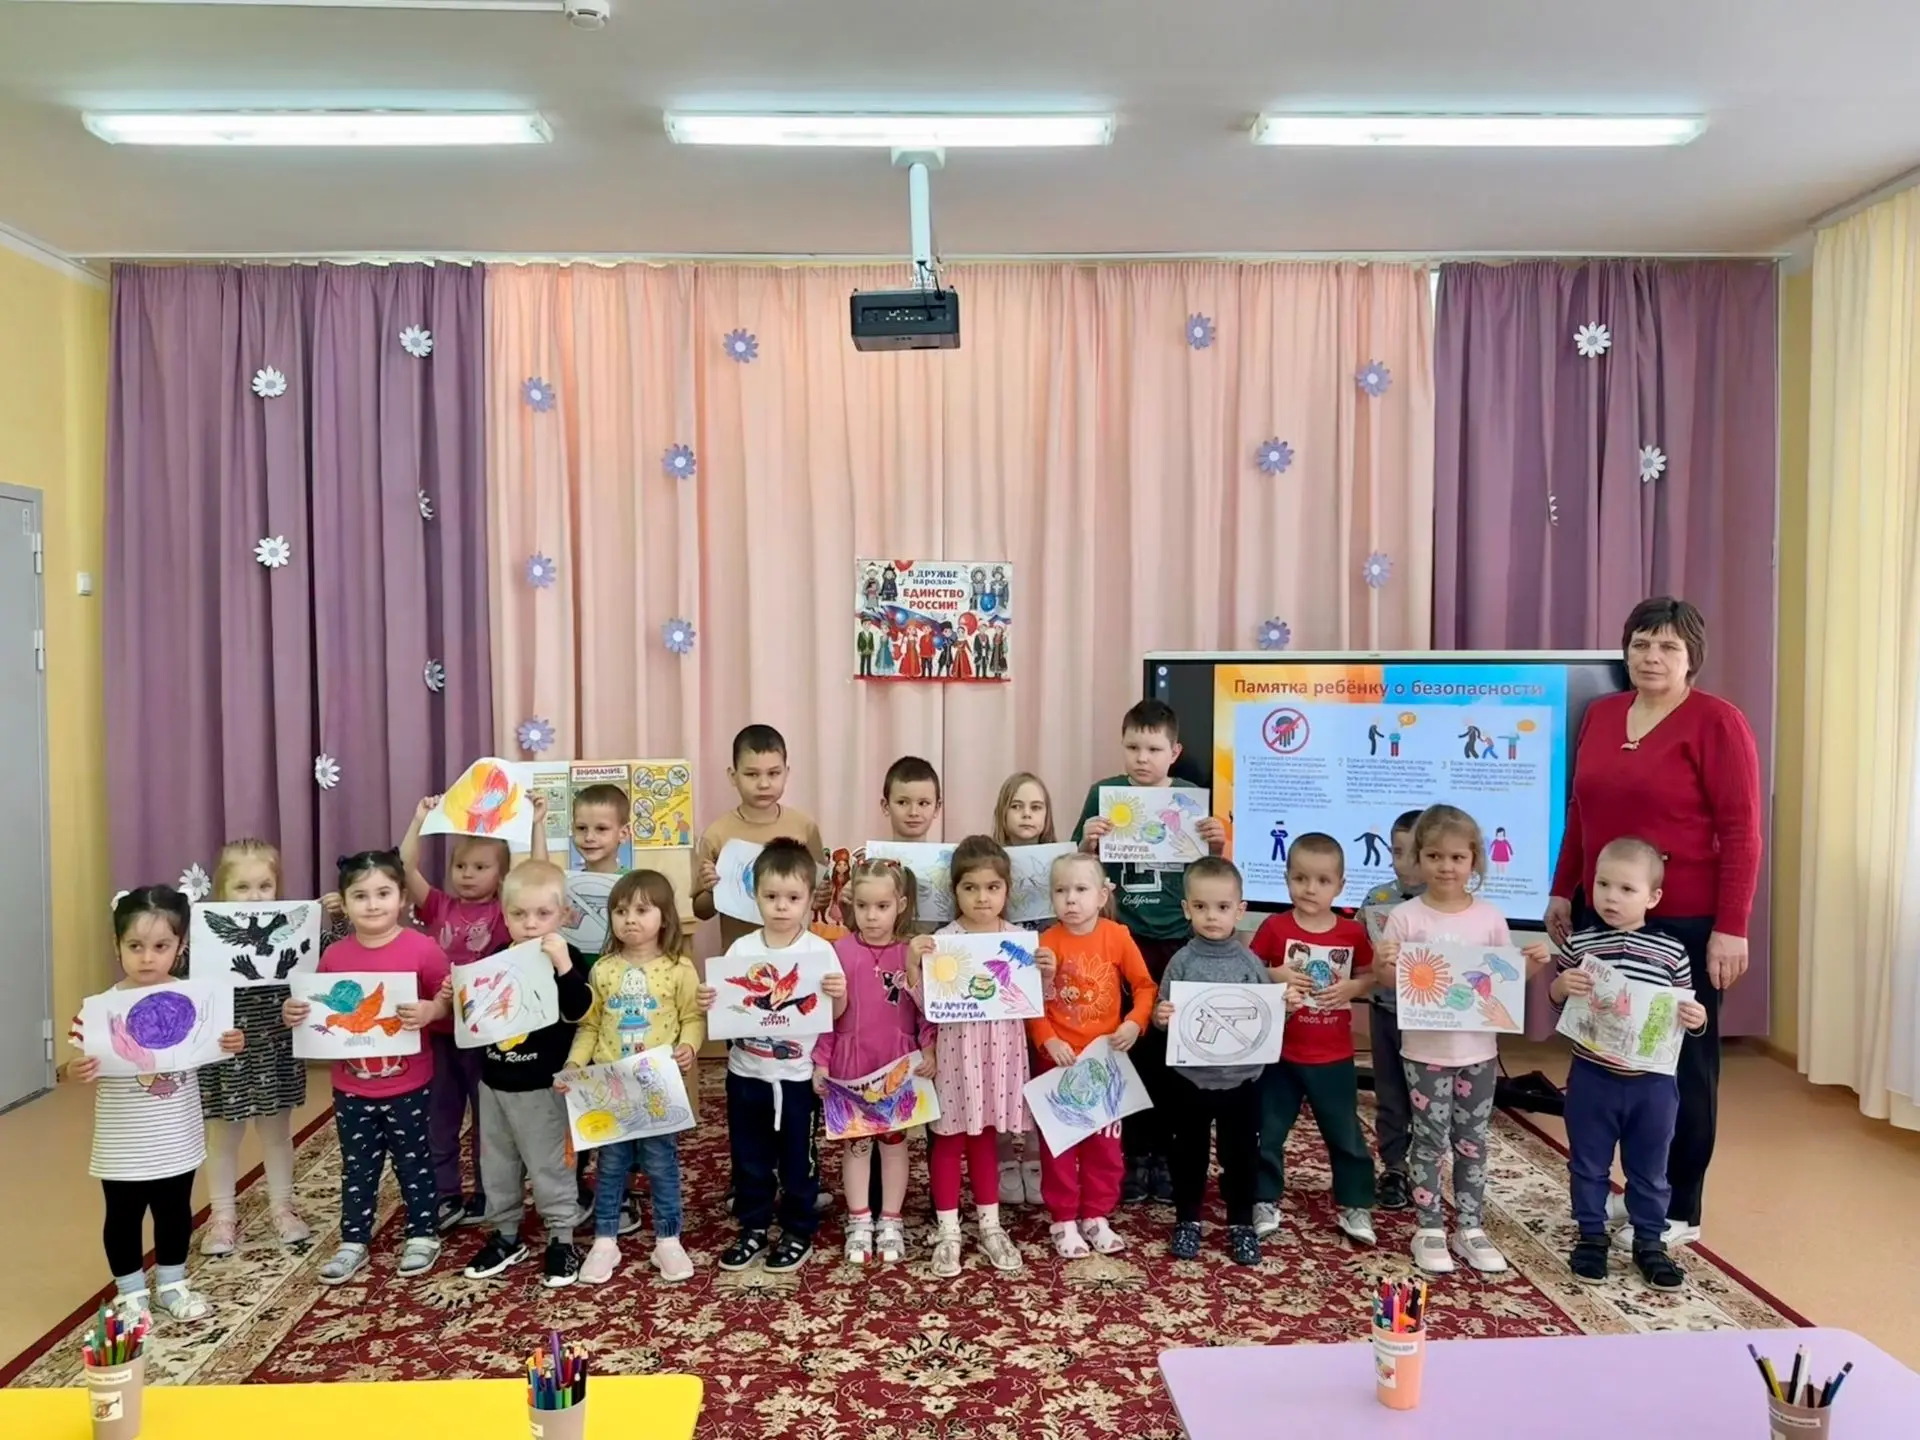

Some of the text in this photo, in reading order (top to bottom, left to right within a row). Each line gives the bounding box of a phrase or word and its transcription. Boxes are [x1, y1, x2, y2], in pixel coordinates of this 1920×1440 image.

[917, 570, 958, 578] ДРУЖБЕ
[903, 588, 965, 599] ЕДИНСТВО
[909, 600, 958, 610] РОССИИ!
[1234, 679, 1543, 697] Памятка ребёнку о безопасности
[505, 1051, 539, 1063] Racer
